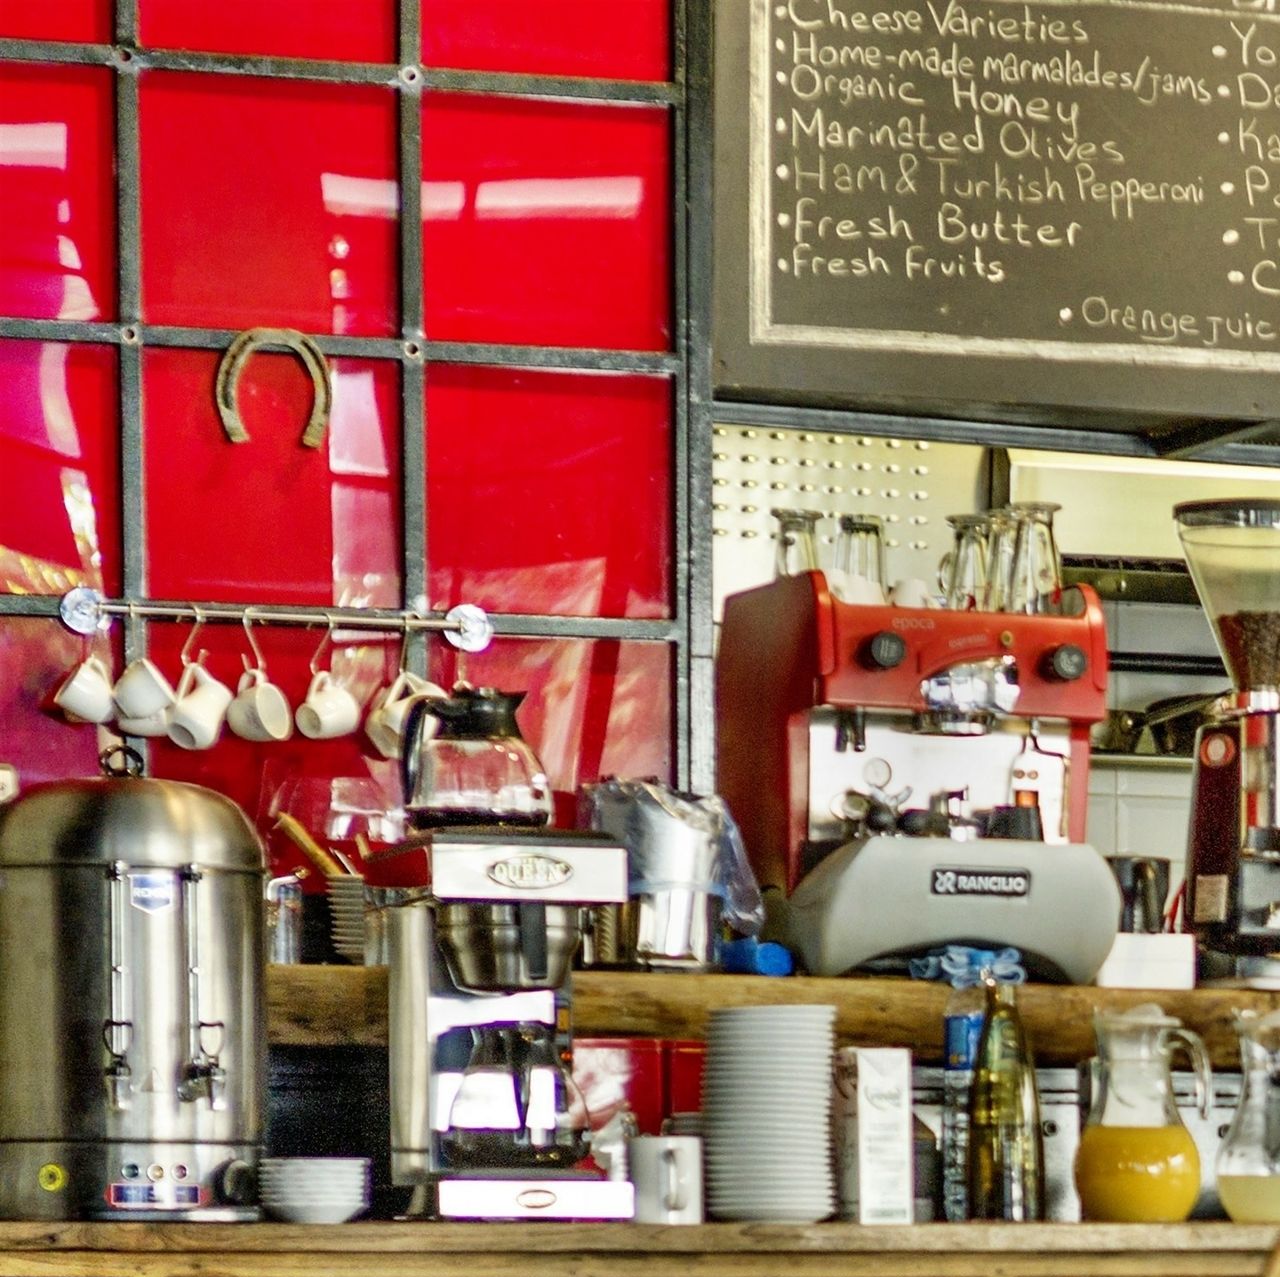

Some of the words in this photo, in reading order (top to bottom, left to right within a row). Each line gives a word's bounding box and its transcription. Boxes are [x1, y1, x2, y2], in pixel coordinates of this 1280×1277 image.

[788, 0, 922, 34] Cheese
[927, 1, 1089, 43] Varieties
[793, 31, 975, 77] Home-made
[790, 64, 925, 105] Organic
[953, 77, 1079, 143] Honey
[791, 107, 984, 153] Marinated
[1000, 120, 1125, 164] Olives
[794, 153, 887, 192] Ham
[896, 152, 918, 194] &
[927, 156, 1065, 203] Turkish
[1075, 163, 1204, 219] Pepperoni
[795, 197, 914, 242] Fresh
[938, 202, 1082, 247] Butter
[1082, 295, 1200, 343] Orange
[958, 875, 1026, 893] RANCILIO
